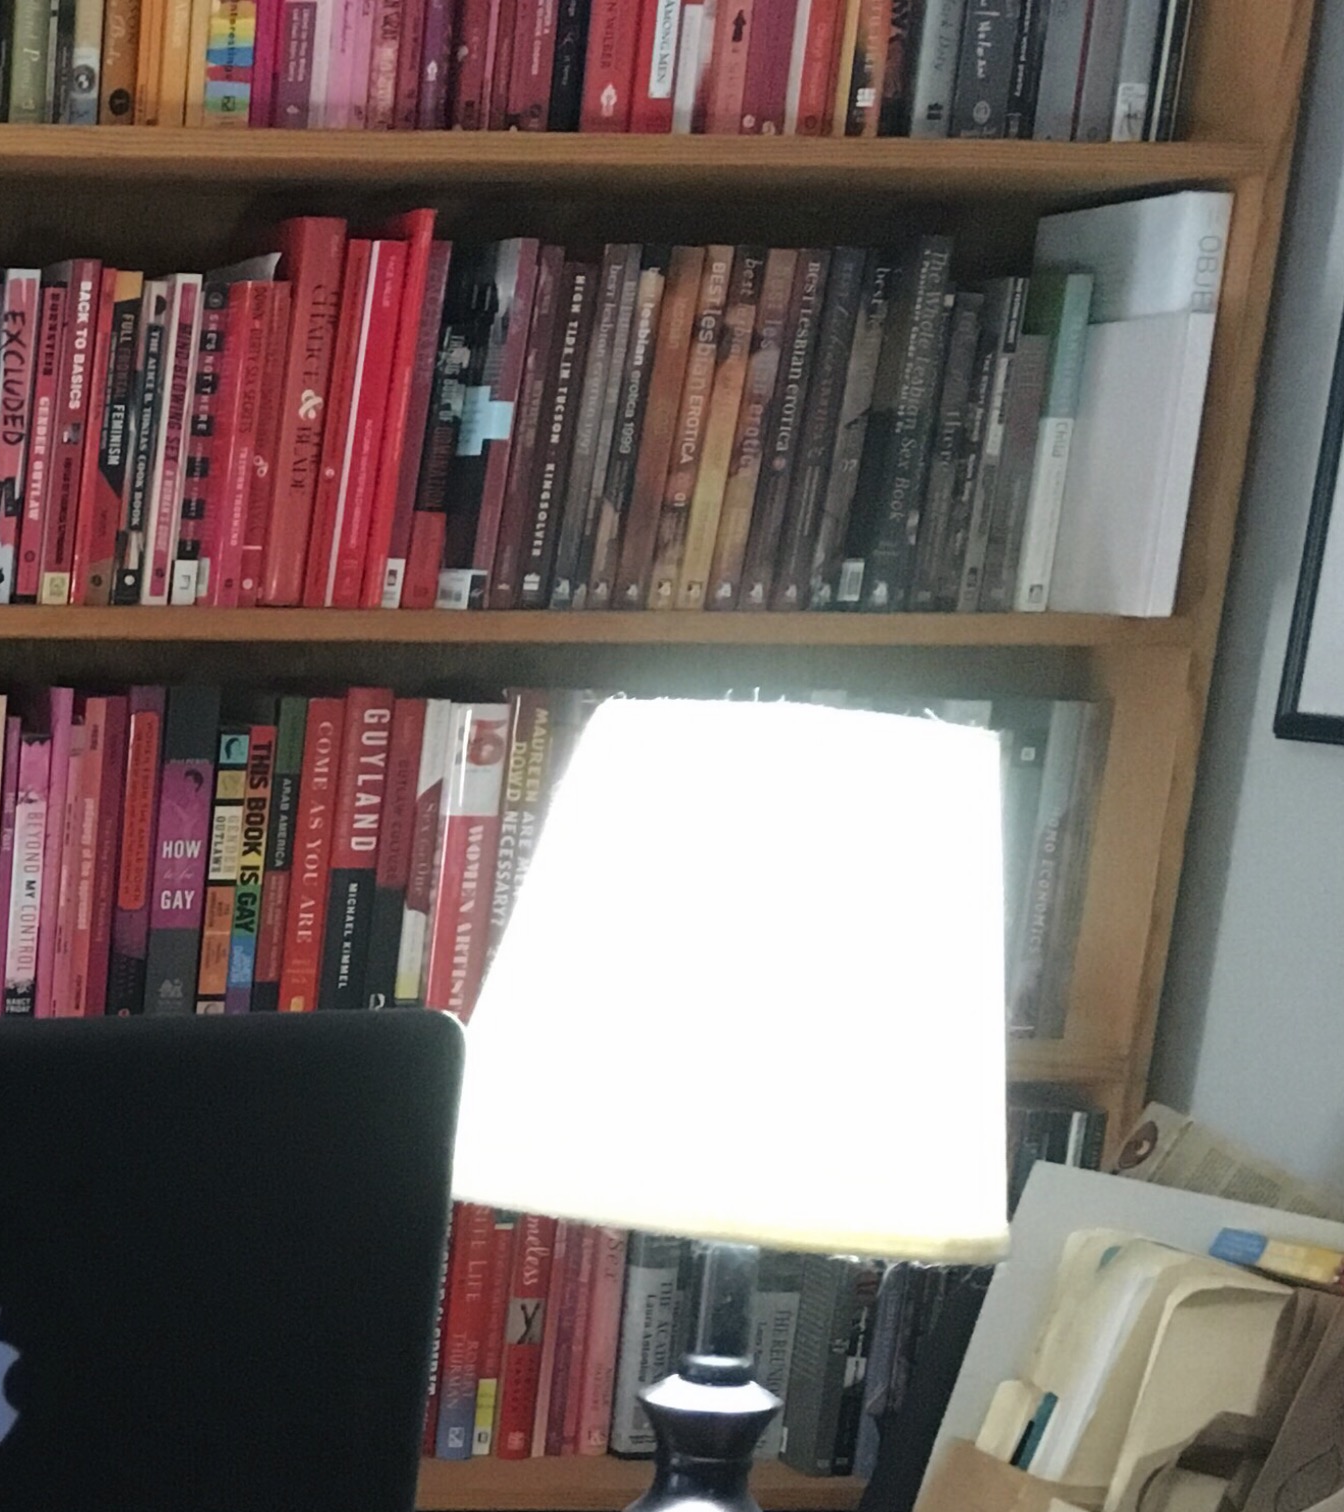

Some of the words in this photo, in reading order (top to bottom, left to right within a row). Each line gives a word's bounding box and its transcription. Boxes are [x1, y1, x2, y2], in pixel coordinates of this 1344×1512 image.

[76, 281, 92, 324] BACK
[75, 328, 87, 348] TO
[119, 314, 134, 343] FULL
[690, 309, 721, 390] lesbian
[2, 310, 26, 445] EXCLUDED
[68, 354, 86, 409] BASICS
[203, 355, 213, 384] NOT
[197, 388, 211, 431] THERE
[679, 394, 703, 463] EROTICA
[108, 405, 126, 465] FEMINISM
[249, 741, 272, 789] THIS
[313, 721, 333, 790] COME
[525, 708, 548, 802] MAUREEN
[350, 708, 390, 851] GUYLAND
[243, 797, 265, 856] BOOK
[308, 800, 327, 830] AS
[161, 840, 202, 860] HOW
[302, 838, 322, 887] YOU
[240, 866, 260, 886] IS
[160, 891, 194, 910] GAY
[235, 892, 257, 934] GAY
[297, 895, 316, 944] ARE
[344, 883, 358, 937] MICHAEL
[337, 942, 351, 989] KIMMEL
